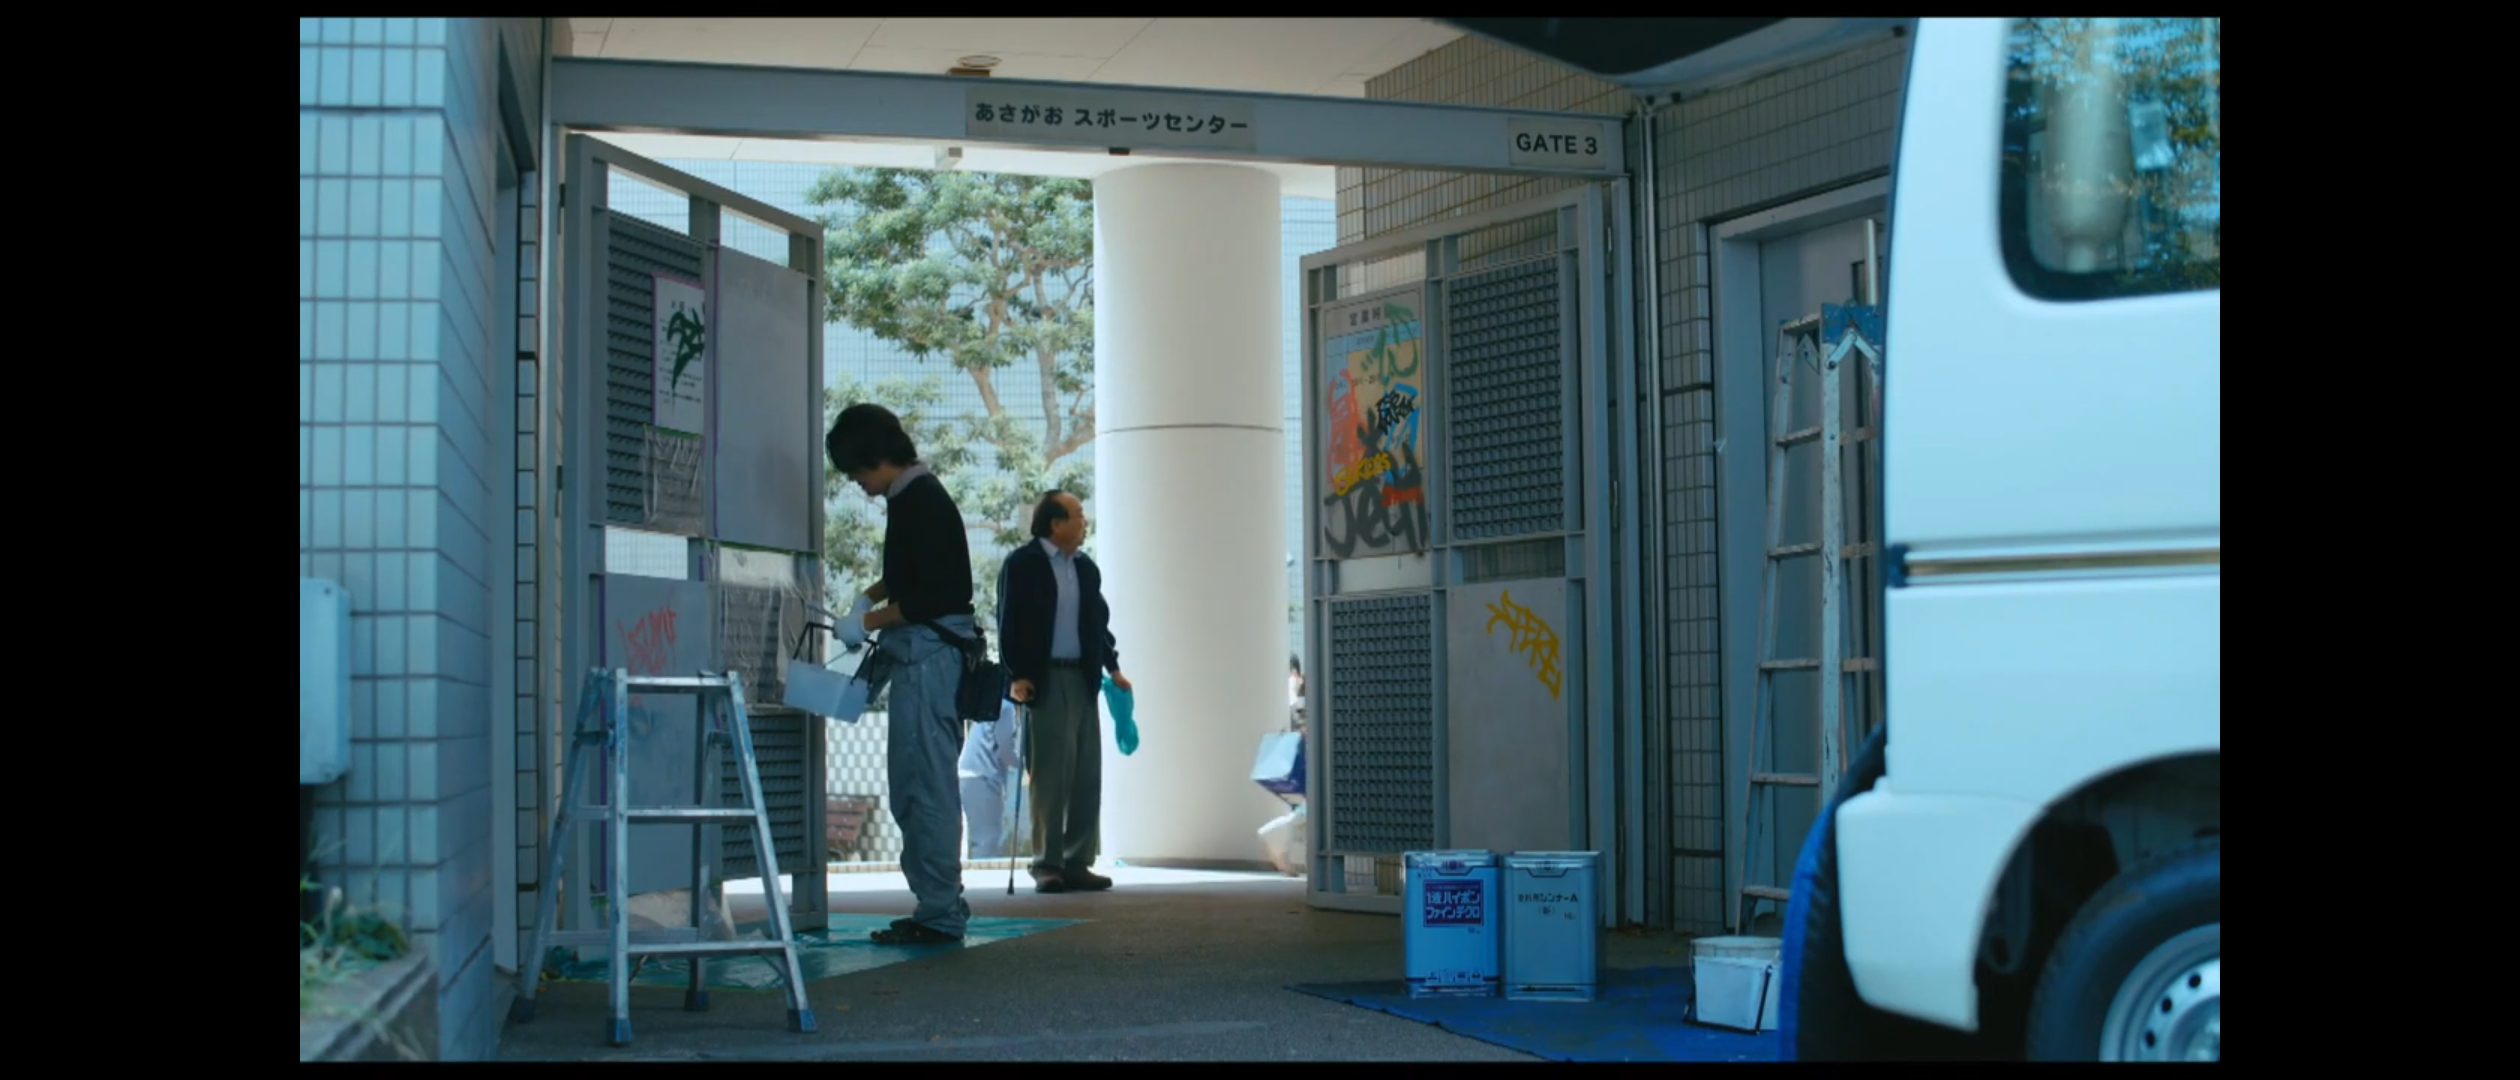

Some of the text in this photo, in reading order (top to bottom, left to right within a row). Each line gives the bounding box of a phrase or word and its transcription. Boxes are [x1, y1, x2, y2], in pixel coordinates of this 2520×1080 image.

[975, 102, 1248, 134] あさがお スポーツセンター
[1516, 133, 1598, 155] GATE 3
